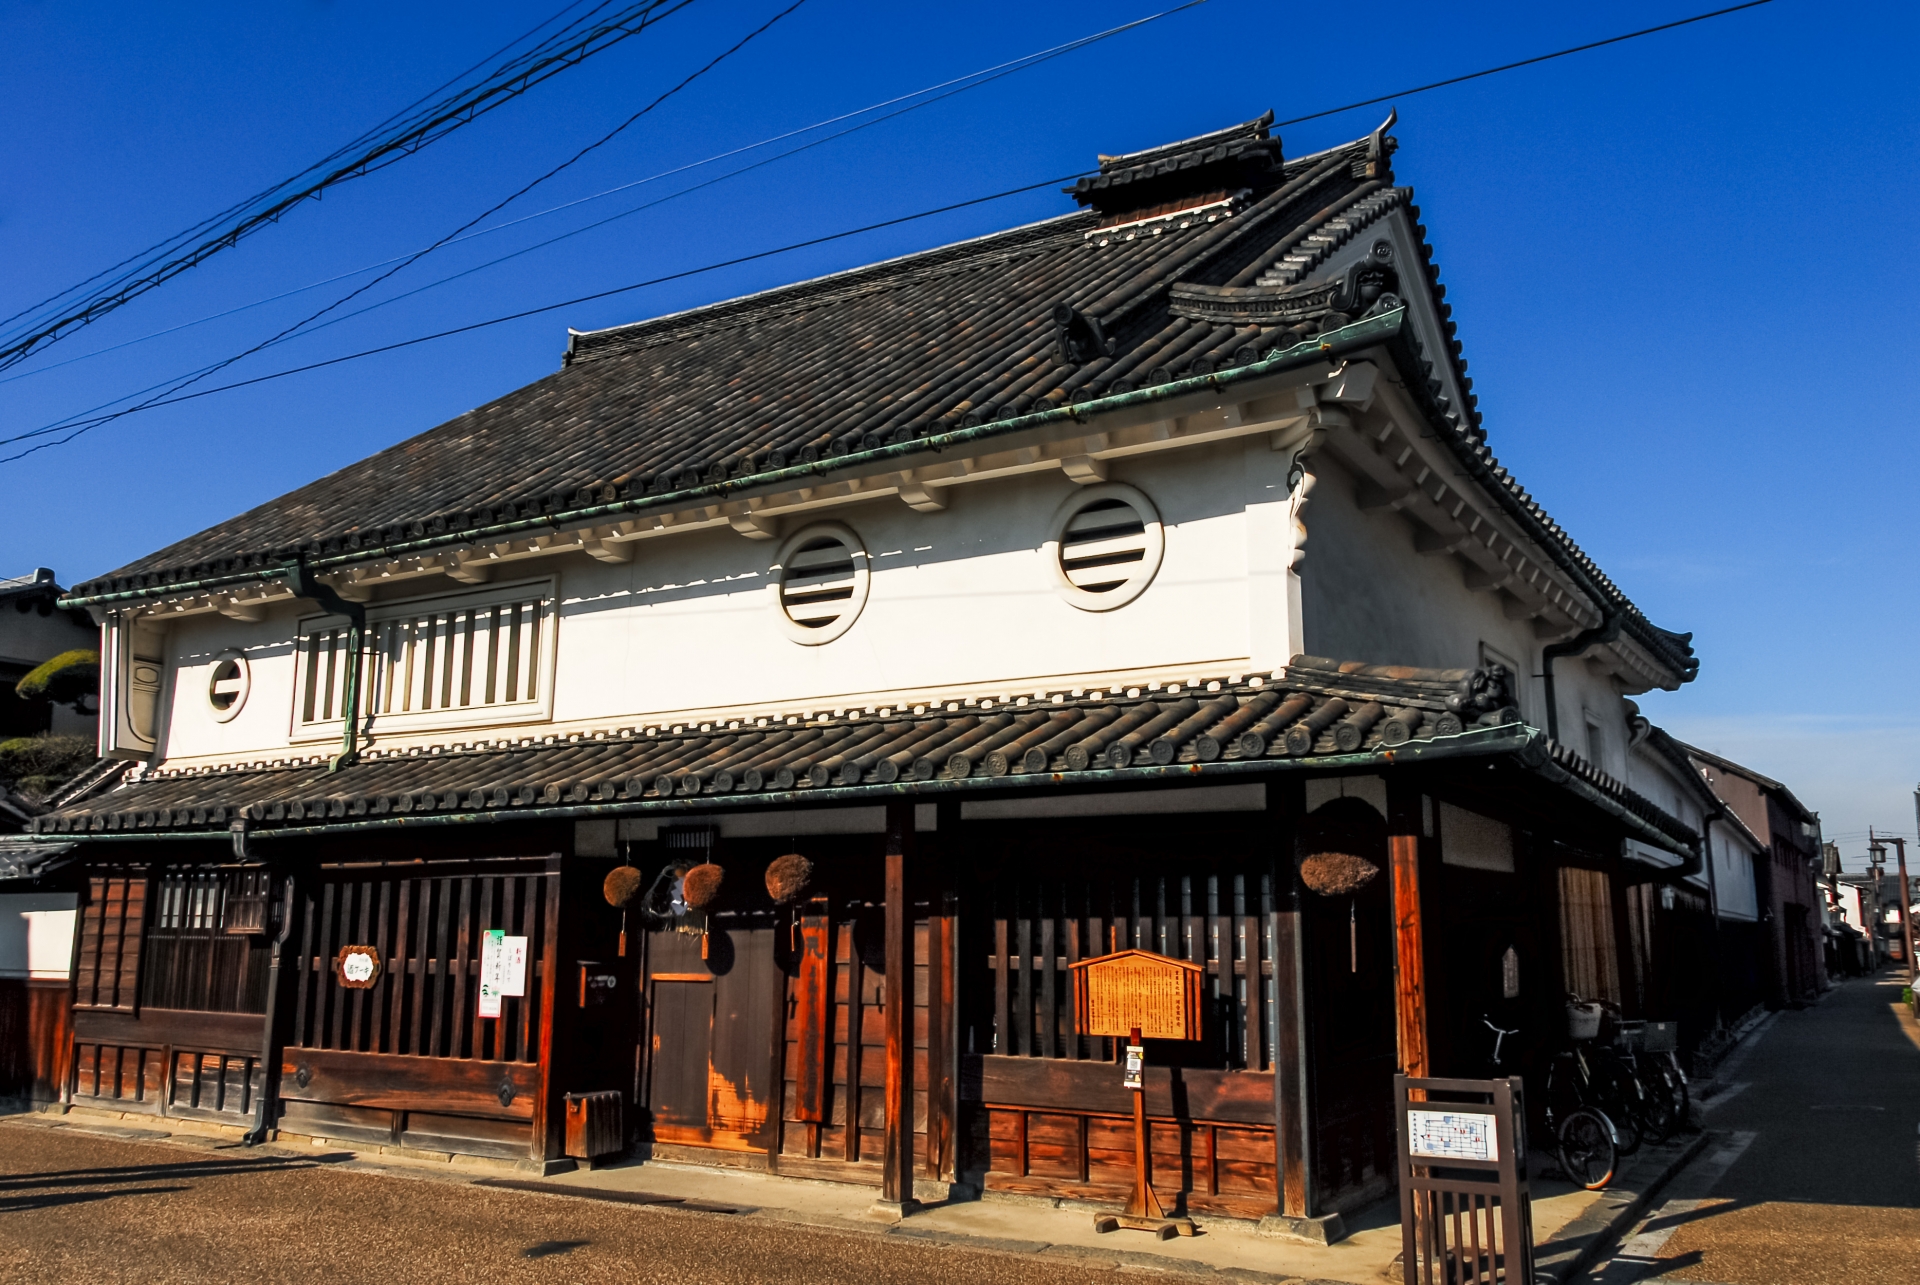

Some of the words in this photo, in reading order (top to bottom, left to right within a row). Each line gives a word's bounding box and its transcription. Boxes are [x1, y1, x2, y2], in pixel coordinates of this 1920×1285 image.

[347, 963, 369, 976] 酒ケーキ
[494, 935, 503, 984] 謹賀新年
